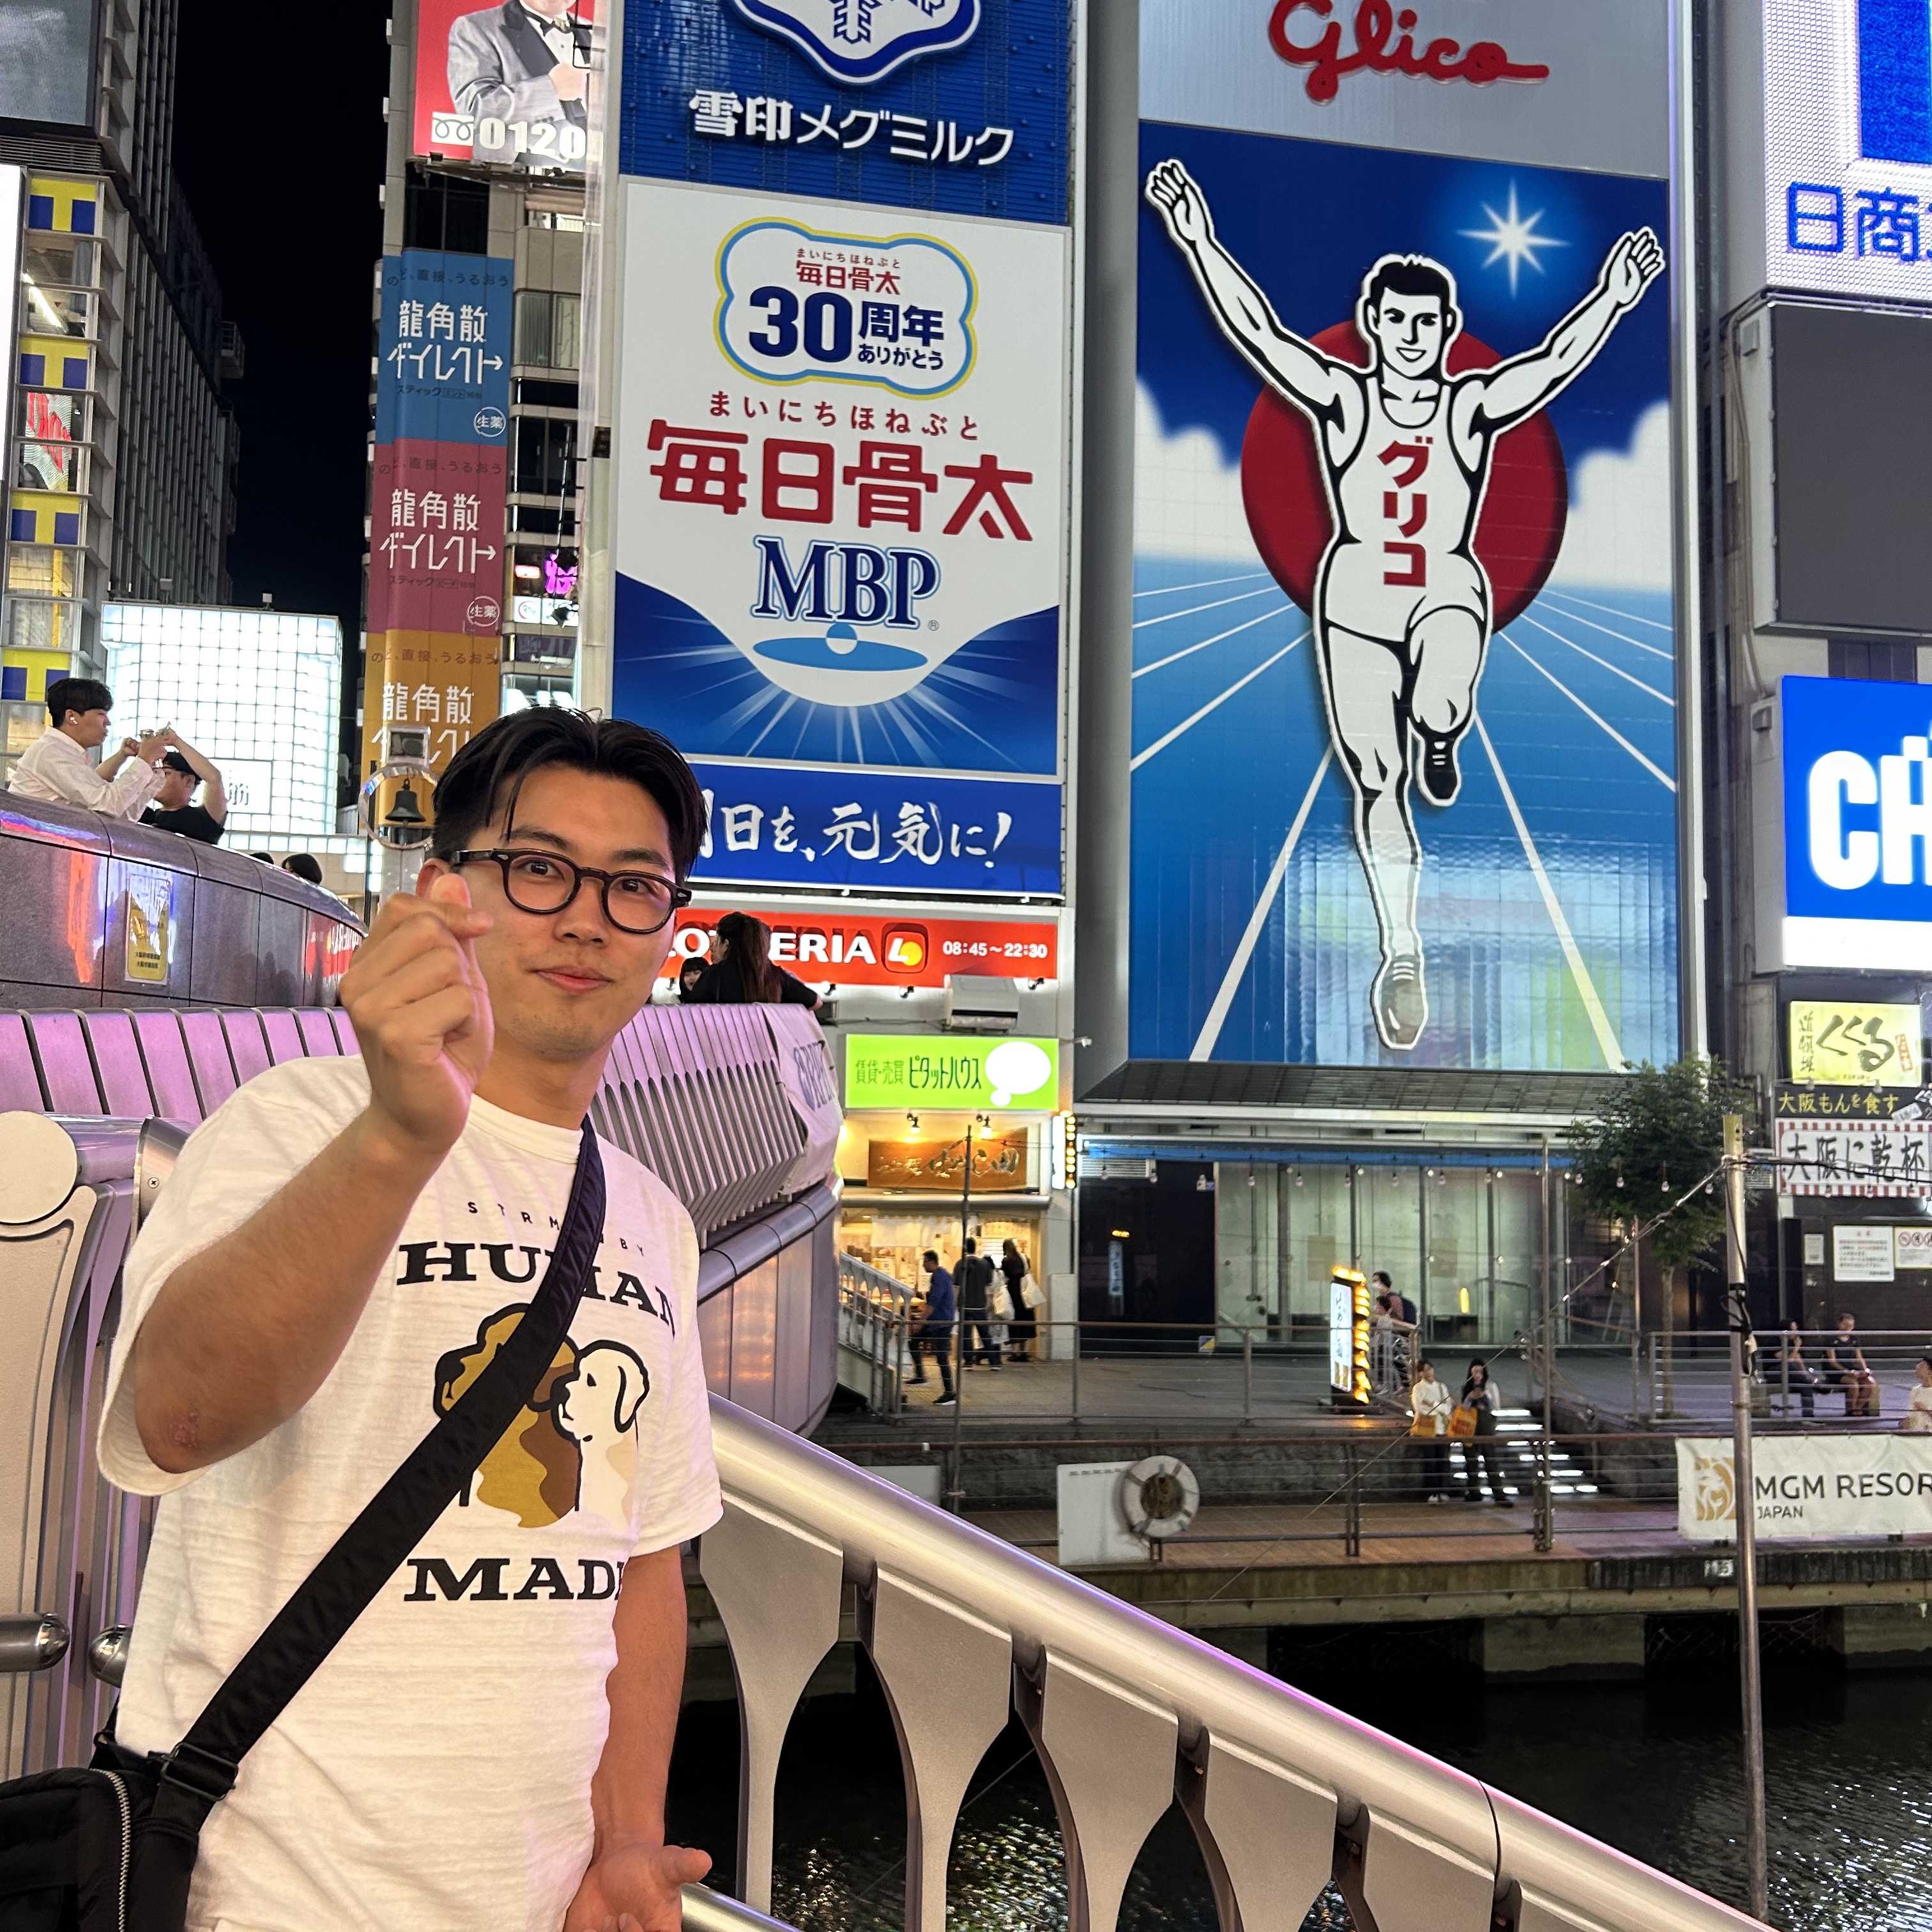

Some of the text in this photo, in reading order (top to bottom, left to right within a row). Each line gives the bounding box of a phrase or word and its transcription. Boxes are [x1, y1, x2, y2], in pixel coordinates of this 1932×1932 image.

[1269, 0, 1550, 104] Glico
[480, 118, 586, 160] 0120
[689, 89, 1015, 165] 雪印メグミルク
[1789, 181, 1932, 261] 日商
[796, 260, 901, 295] 毎日骨太
[797, 248, 901, 269] まいにちほねぶと
[399, 300, 488, 343] 龍角散
[858, 344, 944, 371] ありがとう
[710, 391, 979, 441] まいにちほねぶと
[647, 419, 1033, 542] 毎日骨太
[392, 488, 481, 532] 龍角散
[1377, 435, 1434, 588] グリコ
[751, 535, 940, 629] MBP
[383, 682, 474, 724] 龍角散
[668, 928, 878, 965] OERIA
[1816, 1015, 1895, 1072] くくる
[909, 1055, 982, 1089] ピタットハウス
[1779, 1091, 1899, 1115] 大阪もんを食す
[1787, 1133, 1925, 1183] 大阪に乾杯
[1755, 1472, 1932, 1500] MGM RESOR
[1756, 1505, 1804, 1519] JAPAN
